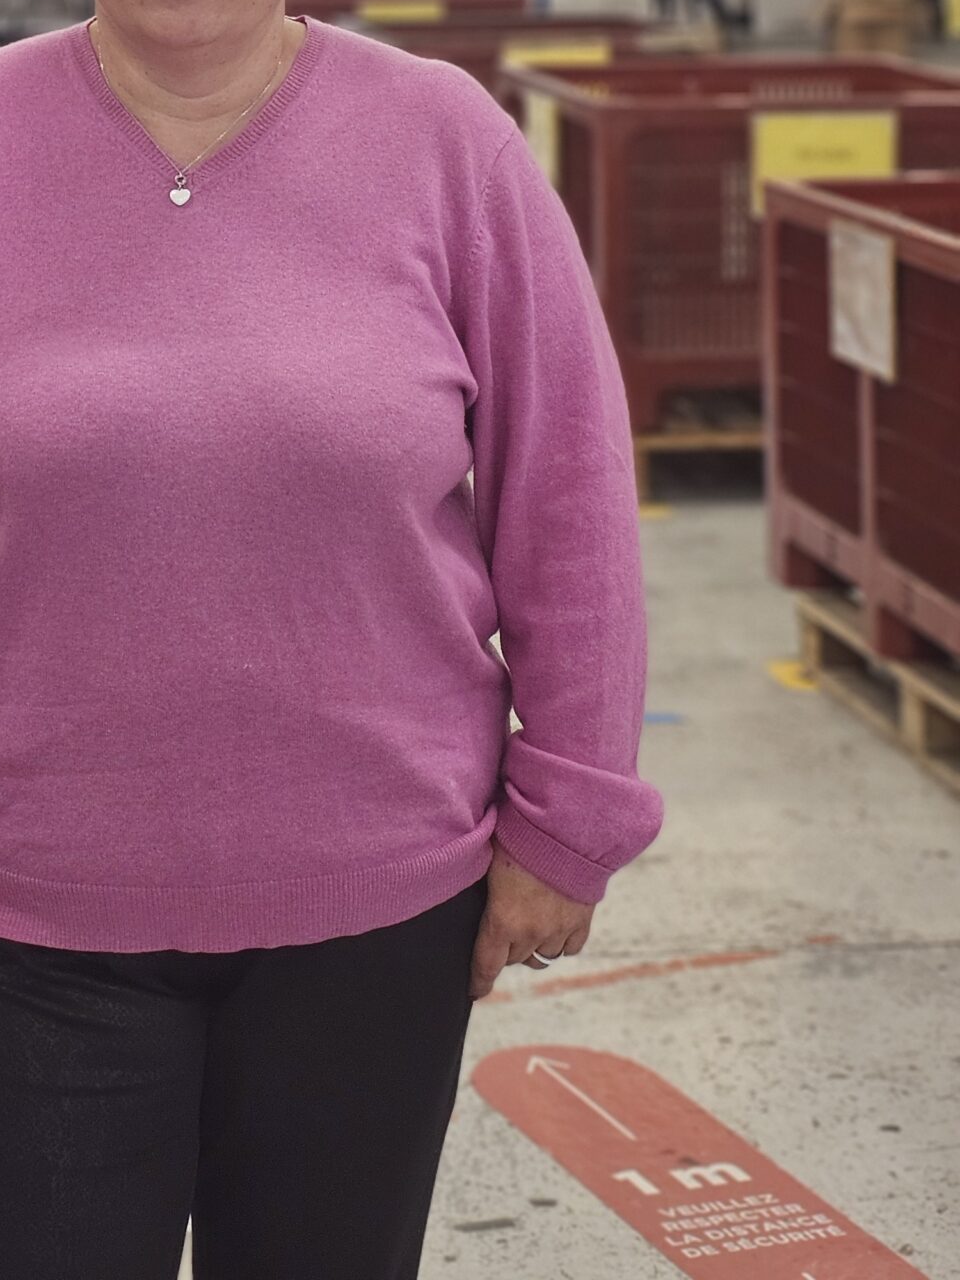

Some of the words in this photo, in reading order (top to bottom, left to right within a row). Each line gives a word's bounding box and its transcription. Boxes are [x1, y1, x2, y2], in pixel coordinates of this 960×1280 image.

[612, 1169, 661, 1196] 1
[669, 1162, 752, 1190] m
[658, 1193, 779, 1218] VEUILLEZ
[661, 1203, 805, 1232] RESPECTER
[664, 1233, 702, 1247] LA
[704, 1213, 832, 1240] DISTANCE
[681, 1244, 720, 1258] DE
